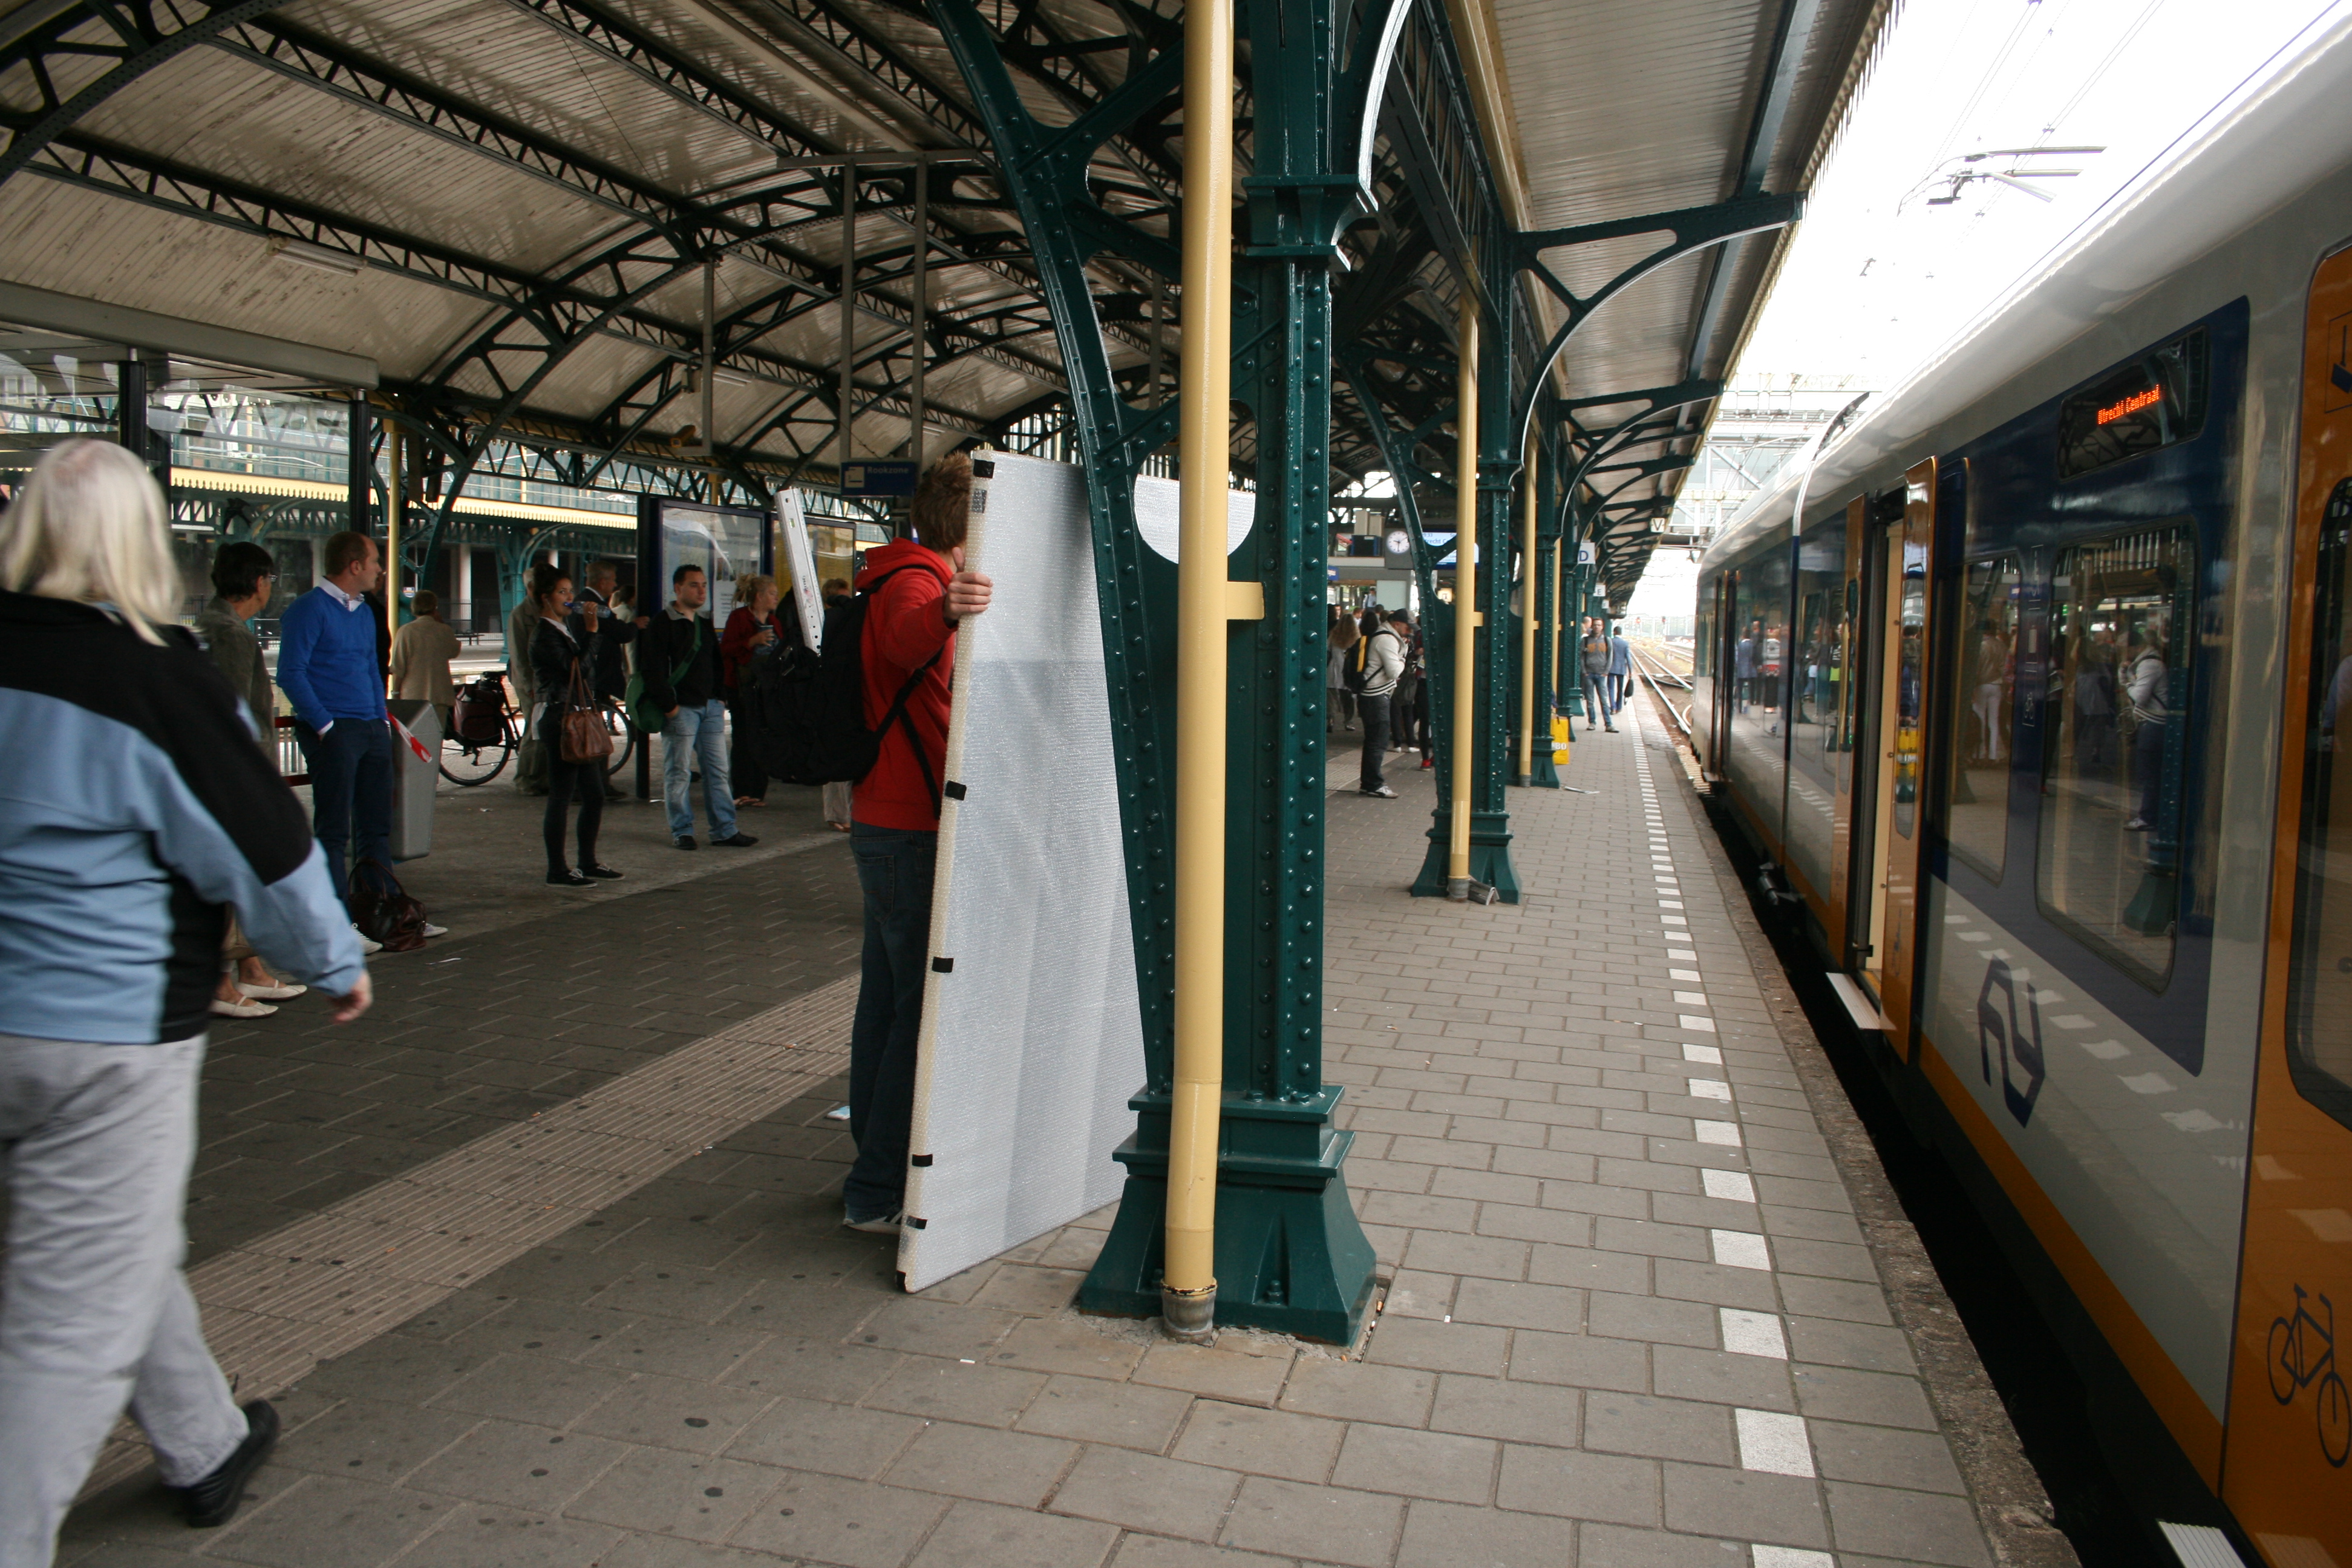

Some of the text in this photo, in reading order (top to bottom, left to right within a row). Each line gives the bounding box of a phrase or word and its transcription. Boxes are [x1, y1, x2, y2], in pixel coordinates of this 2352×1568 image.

[2098, 384, 2159, 425] Utrecht Centraal
[1653, 518, 1663, 531] V
[1579, 550, 1589, 561] D
